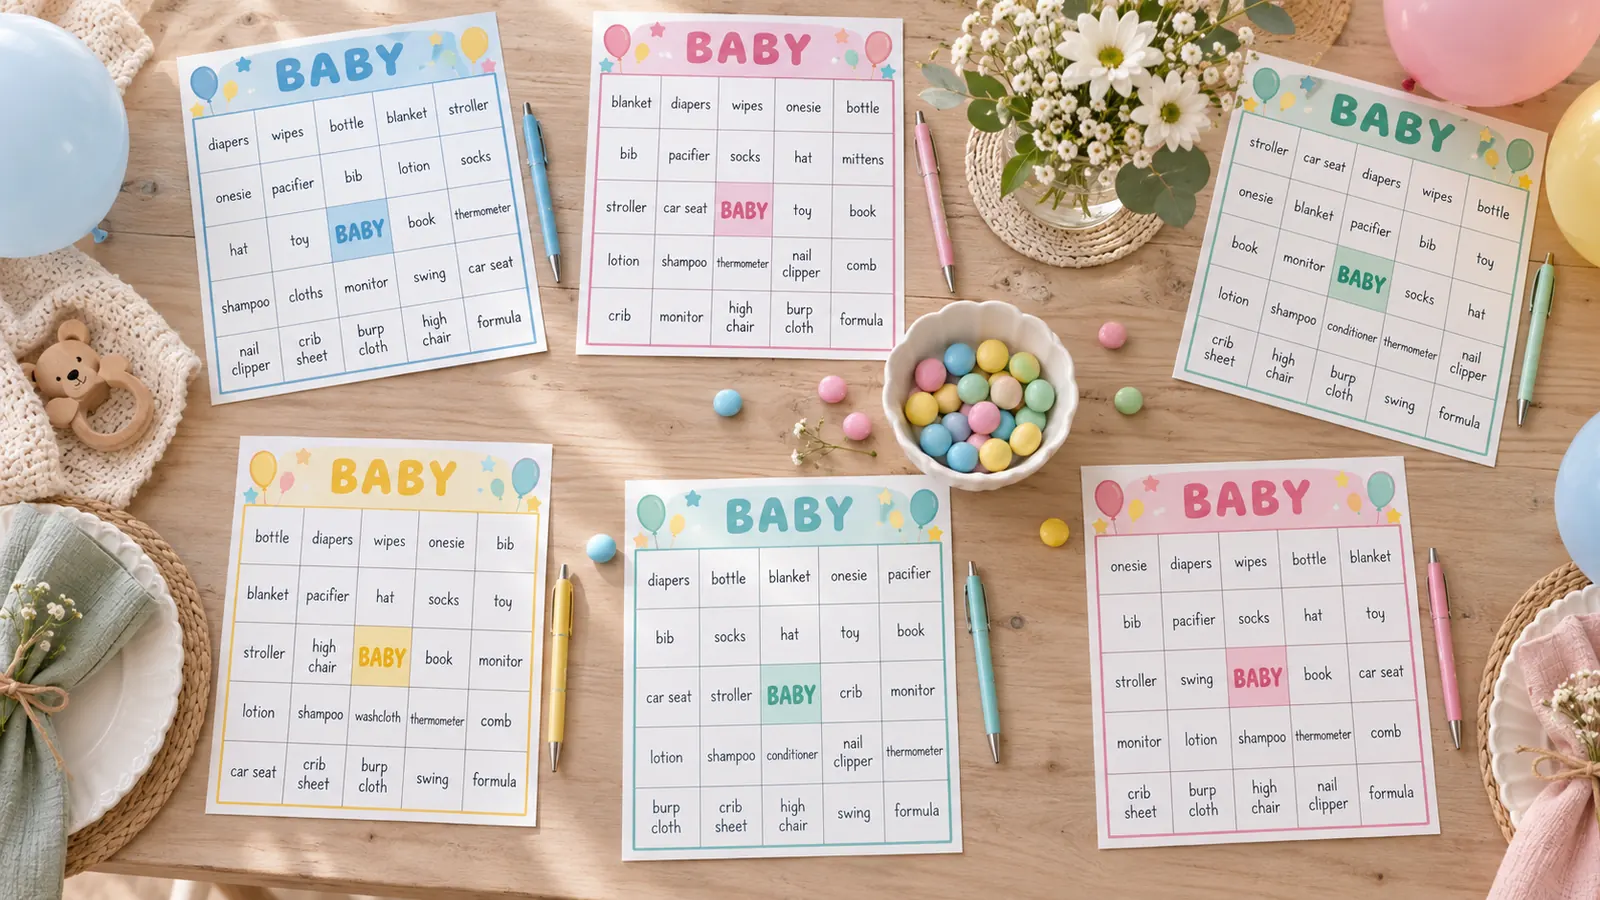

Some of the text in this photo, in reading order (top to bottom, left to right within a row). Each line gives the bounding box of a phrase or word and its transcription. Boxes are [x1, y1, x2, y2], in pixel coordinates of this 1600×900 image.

[687, 31, 811, 66] BABY
[276, 42, 403, 92] BABY
[449, 98, 489, 115] stroller
[612, 95, 652, 108] blanket
[732, 100, 763, 114] wipes
[786, 101, 821, 113] onesie
[847, 100, 879, 114] bottle
[386, 107, 427, 124] blanket
[1330, 93, 1456, 152] BABY
[329, 116, 364, 132] bottle
[208, 137, 249, 152] diapers
[1250, 138, 1289, 156] stroller
[461, 150, 491, 165] socks
[620, 146, 638, 160] bib
[669, 147, 710, 164] pacifier
[795, 150, 812, 163] hat
[842, 153, 884, 165] mittens
[398, 162, 430, 175] lotion
[1362, 168, 1401, 189] diapers
[272, 177, 314, 199] pacifier
[1423, 188, 1452, 203] wipes
[454, 204, 511, 219] thermometer
[606, 199, 647, 213] stroller
[663, 202, 708, 214] car seat
[721, 201, 768, 220] BABY
[793, 204, 812, 220] toy
[1294, 199, 1334, 221] blanket
[1477, 199, 1510, 220] bottle
[407, 212, 436, 228] book
[334, 218, 384, 244] BABY
[229, 242, 248, 256] hat
[290, 235, 309, 248] toy
[1231, 235, 1258, 254] book
[1419, 235, 1436, 251] bib
[662, 254, 707, 271] shampoo
[716, 256, 769, 268] thermometer
[792, 248, 811, 261] nail
[1477, 252, 1494, 271] toy
[468, 256, 513, 274] car seat
[846, 258, 877, 271] comb
[1283, 255, 1325, 272] monitor
[414, 269, 446, 283] swing
[782, 264, 821, 282] clipper
[1337, 265, 1387, 294] BABY
[344, 277, 388, 293] monitor
[289, 286, 323, 303] cloths
[1405, 290, 1434, 305] socks
[608, 308, 631, 322] crib
[660, 310, 704, 323] monitor
[729, 300, 753, 318] high
[787, 301, 813, 319] burp
[1270, 302, 1317, 325] shampoo
[422, 311, 447, 330] high
[726, 319, 755, 332] chair
[785, 320, 813, 333] cloth
[299, 331, 321, 347] crib
[357, 324, 384, 338] burp
[423, 332, 451, 346] chair
[1327, 323, 1378, 343] conditioner
[240, 341, 259, 357] nail
[359, 339, 388, 356] cloth
[1212, 335, 1234, 349] crib
[1383, 336, 1438, 360] thermometer
[296, 350, 328, 366] sheet
[1204, 348, 1235, 367] sheet
[1272, 347, 1295, 368] high
[1462, 351, 1482, 364] nail
[232, 361, 270, 378] clipper
[1266, 366, 1294, 383] chair
[1330, 365, 1356, 387] burp
[1450, 362, 1487, 382] clipper
[1325, 384, 1353, 402] cloth
[1384, 395, 1415, 415] swing
[331, 458, 457, 496] BABY
[1184, 479, 1310, 519] BABY
[726, 496, 853, 534] BABY
[255, 529, 289, 544] bottle
[374, 534, 405, 551] wipes
[429, 537, 465, 549] onesie
[497, 536, 514, 550] bib
[1234, 556, 1267, 572] wipes
[1292, 551, 1327, 566] bottle
[1350, 549, 1391, 563] blanket
[1110, 560, 1147, 572] onesie
[648, 572, 690, 591] diapers
[769, 569, 811, 583] blanket
[831, 569, 867, 582] onesie
[888, 565, 931, 584] pacifier
[247, 585, 289, 601] blanket
[306, 587, 350, 605] pacifier
[428, 591, 459, 606] socks
[494, 594, 512, 612] toy
[1173, 611, 1216, 631] pacifier
[1304, 608, 1323, 621] hat
[1366, 607, 1385, 623] toy
[714, 628, 746, 643] socks
[841, 626, 859, 643] toy
[897, 622, 925, 637] book
[244, 644, 285, 659] stroller
[312, 638, 336, 658] high
[359, 646, 407, 668] BABY
[425, 650, 453, 665] book
[308, 658, 337, 673] chair
[1304, 665, 1332, 681] book
[1359, 665, 1404, 679] car seat
[1115, 673, 1157, 688] stroller
[1181, 673, 1213, 689] swing
[1233, 667, 1283, 688] BABY
[646, 690, 692, 704] car seat
[711, 687, 752, 702] stroller
[767, 684, 816, 706] BABY
[840, 684, 863, 699] crib
[298, 704, 344, 724] shampoo
[355, 709, 401, 723] washcloth
[410, 712, 465, 727] thermometer
[481, 713, 512, 728] comb
[843, 734, 863, 749] nail
[1185, 732, 1217, 746] lotion
[1238, 729, 1286, 747] shampoo
[1295, 729, 1352, 741] thermometer
[707, 748, 756, 766] shampoo
[766, 747, 818, 761] conditioner
[886, 745, 944, 757] thermometer
[303, 756, 326, 771] crib
[361, 757, 388, 777] burp
[833, 753, 873, 771] clipper
[230, 766, 277, 778] car seat
[298, 775, 330, 790] sheet
[358, 777, 387, 793] cloth
[417, 772, 449, 790] swing
[1252, 779, 1277, 798] high
[1317, 777, 1337, 792] nail
[1128, 784, 1151, 800] crib
[1189, 782, 1216, 800] burp
[653, 799, 680, 818] burp
[719, 798, 742, 813] crib
[781, 798, 805, 817] high
[1124, 804, 1157, 819] sheet
[1189, 801, 1218, 817] cloth
[1252, 799, 1280, 814] chair
[1309, 796, 1348, 815] clipper
[838, 806, 871, 823] swing
[651, 819, 681, 834] cloth
[715, 818, 747, 833] sheet
[779, 817, 808, 832] chair
